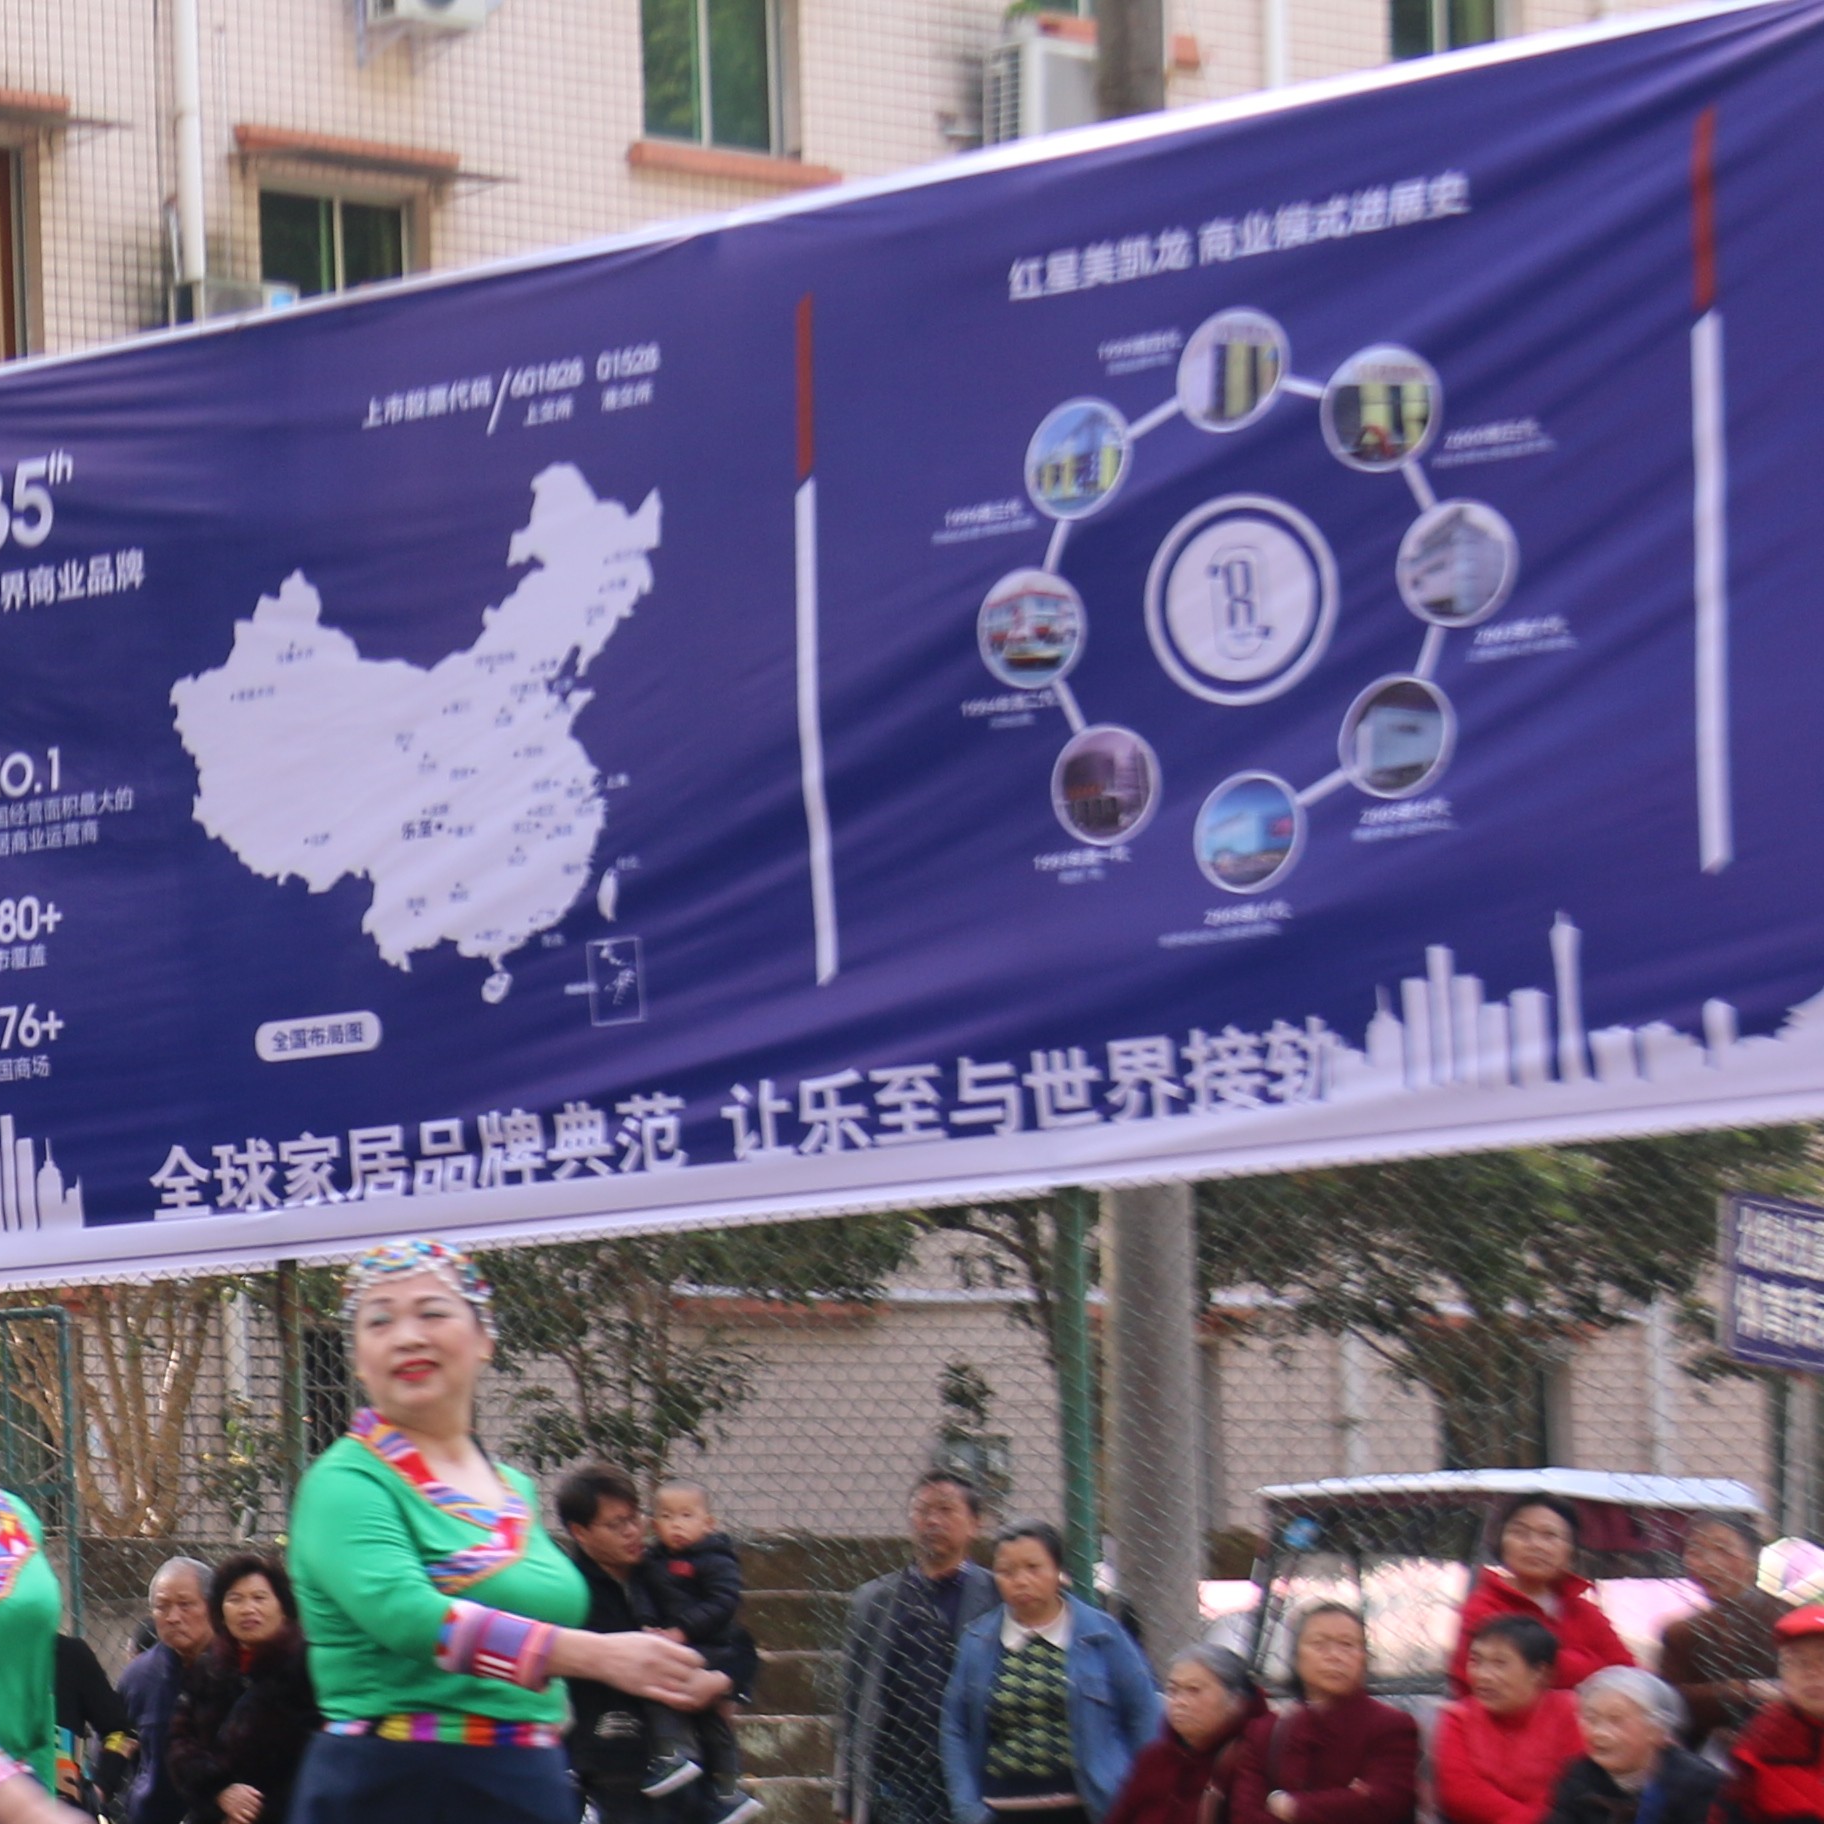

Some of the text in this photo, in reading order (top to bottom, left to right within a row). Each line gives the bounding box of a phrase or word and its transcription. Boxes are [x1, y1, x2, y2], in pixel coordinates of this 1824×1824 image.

[1008, 226, 1193, 301] 红星美凯龙
[271, 1021, 364, 1052] 全国布局图
[150, 1014, 1340, 1221] 全球家居品牌典范 让乐至与世界接轨
